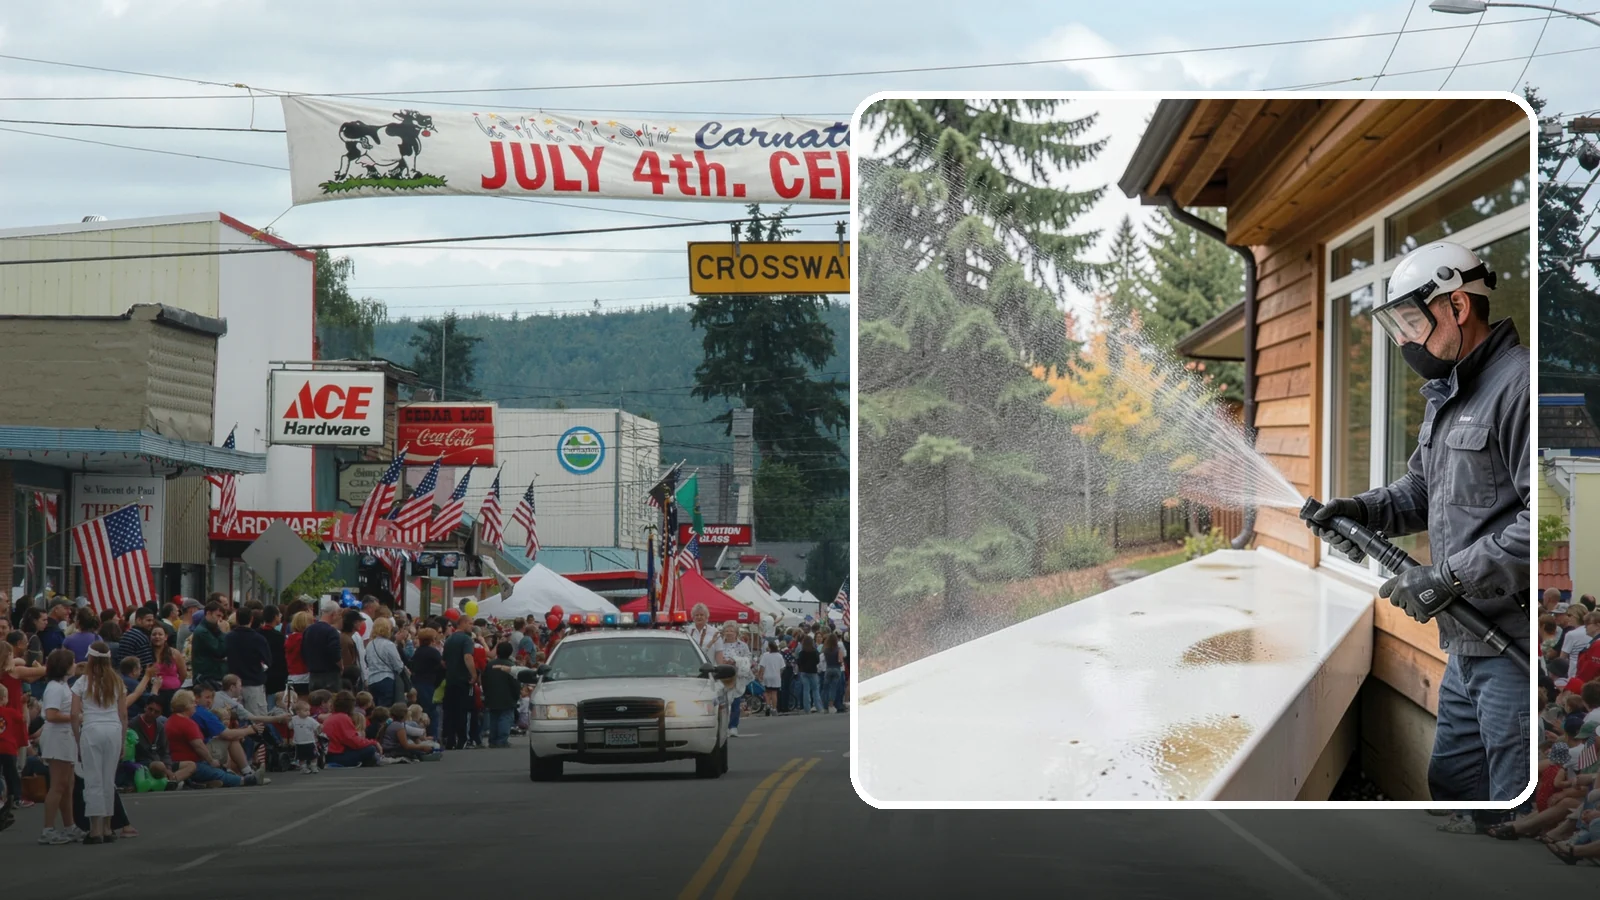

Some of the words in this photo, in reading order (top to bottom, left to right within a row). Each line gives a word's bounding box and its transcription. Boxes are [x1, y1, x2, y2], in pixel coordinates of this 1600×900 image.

[481, 141, 604, 192] JULY
[632, 150, 746, 198] 4th.
[697, 254, 850, 280] CROSSWA
[282, 380, 373, 420] ACE
[405, 409, 452, 422] CEDAR
[461, 409, 484, 422] LOG
[283, 421, 370, 436] Hardware
[416, 428, 476, 446] Coca-Cola
[353, 467, 385, 480] Simpl
[95, 485, 124, 494] Vincent
[126, 486, 136, 495] de
[137, 486, 155, 495] Paul
[688, 526, 742, 535] CRNATION
[699, 535, 730, 543] GLASS
